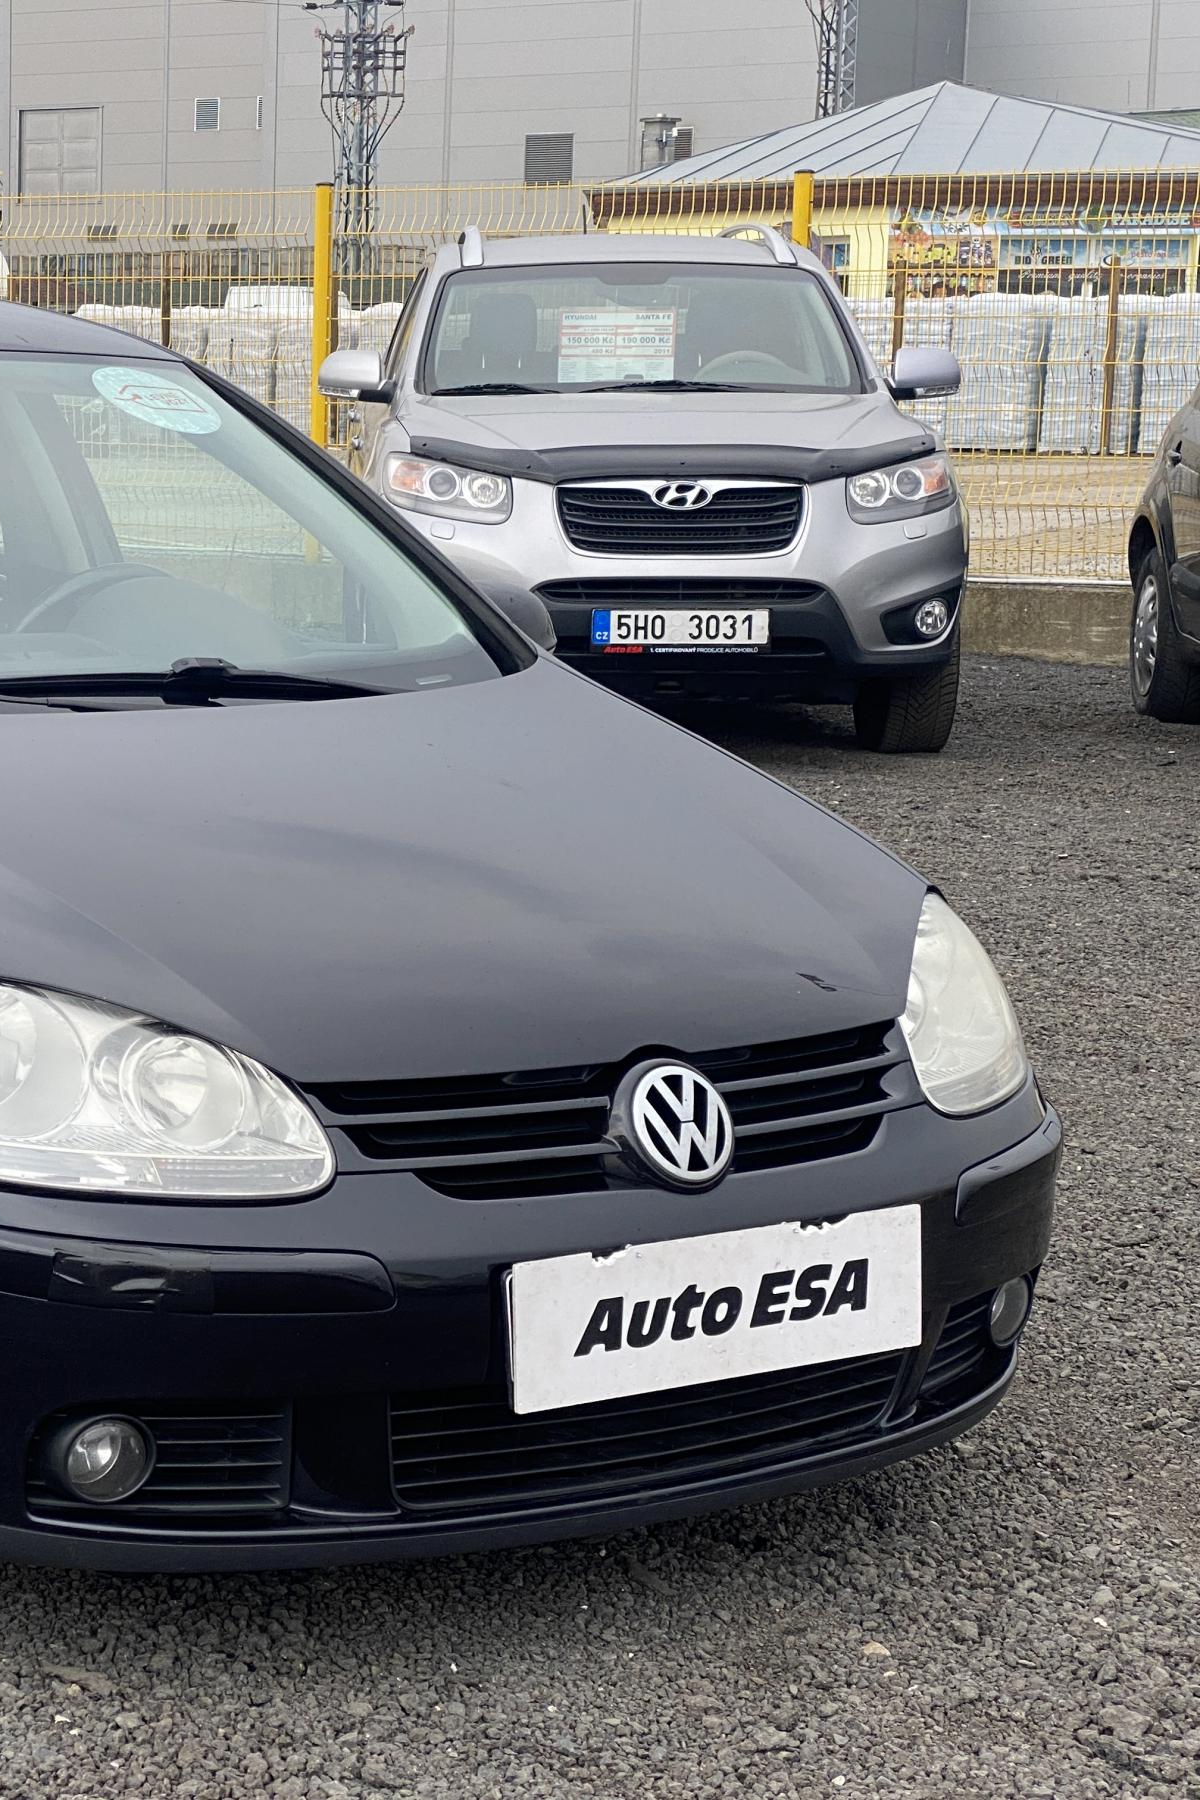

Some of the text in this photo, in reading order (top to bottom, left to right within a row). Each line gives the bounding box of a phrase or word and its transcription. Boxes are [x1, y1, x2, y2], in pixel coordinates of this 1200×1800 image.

[1014, 255, 1073, 265] BIO GREEN
[567, 336, 582, 344] 150
[584, 336, 600, 344] 000
[639, 336, 656, 344] 000
[616, 614, 754, 640] 5H0 3031
[595, 632, 609, 640] CZ
[603, 646, 643, 654] Auto ESA
[573, 1258, 869, 1357] Auto ESA
